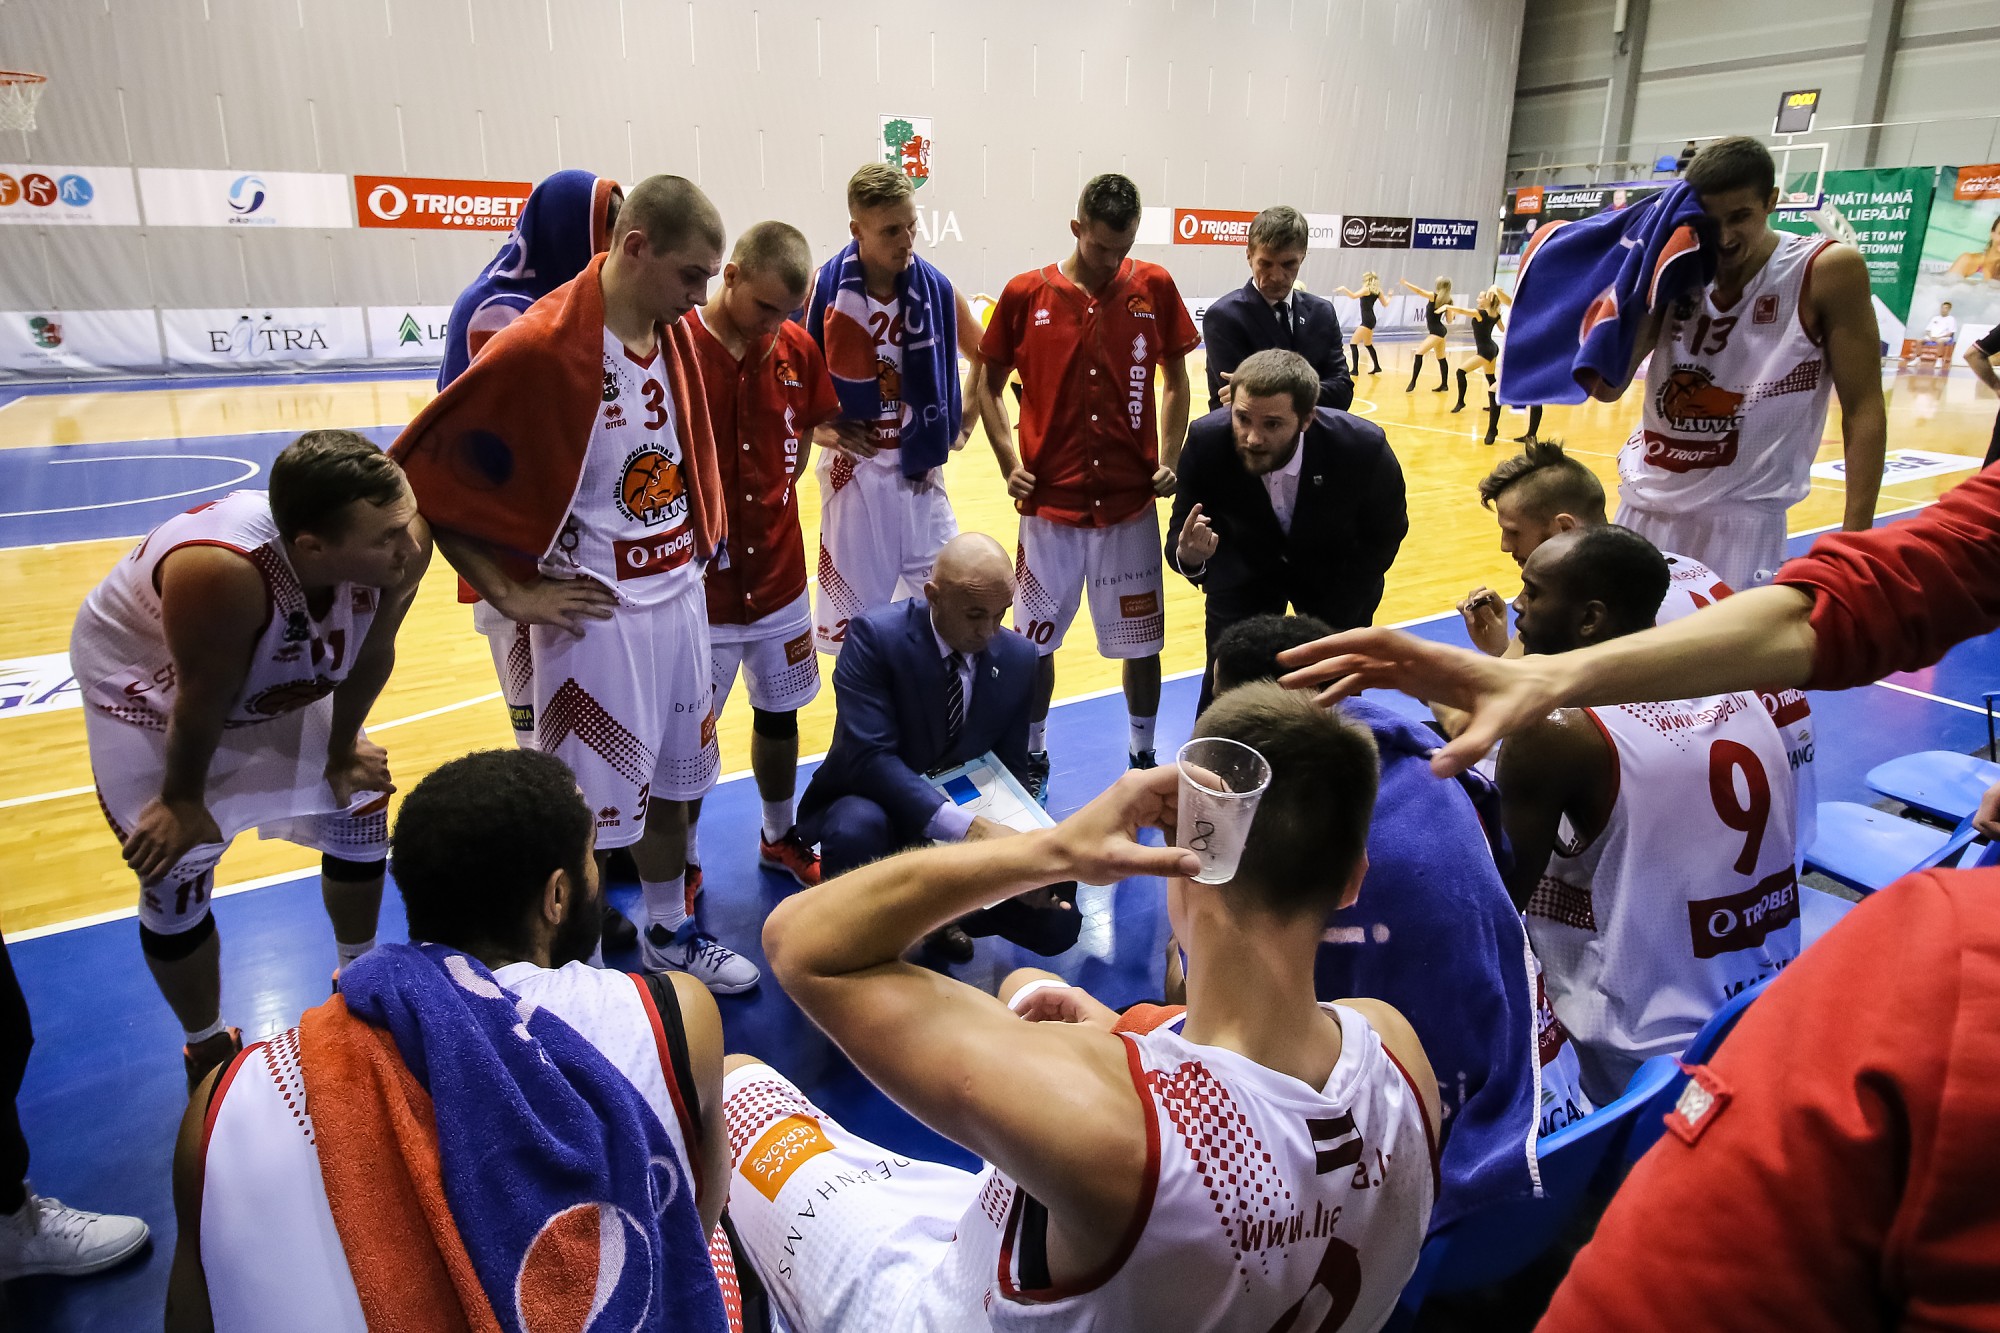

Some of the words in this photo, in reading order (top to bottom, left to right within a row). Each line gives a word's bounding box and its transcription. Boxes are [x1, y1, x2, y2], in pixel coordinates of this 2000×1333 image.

[412, 194, 525, 216] TRIOBET
[1870, 188, 1913, 204] MANĀ
[476, 216, 517, 227] SPORTS
[1847, 206, 1911, 221] LIEPĀJĀ!
[1200, 220, 1252, 235] TRIOBET
[1417, 223, 1449, 234] HOTEL
[1871, 232, 1887, 240] TO
[1888, 231, 1906, 241] MY
[1690, 315, 1738, 356] 13
[641, 378, 668, 430] 3
[1128, 366, 1146, 429] errea
[605, 418, 627, 430] errea
[1026, 619, 1055, 645] 10
[633, 782, 650, 821] 3
[1708, 739, 1771, 876] 9
[597, 820, 620, 828] errea
[1189, 821, 1215, 851] 8
